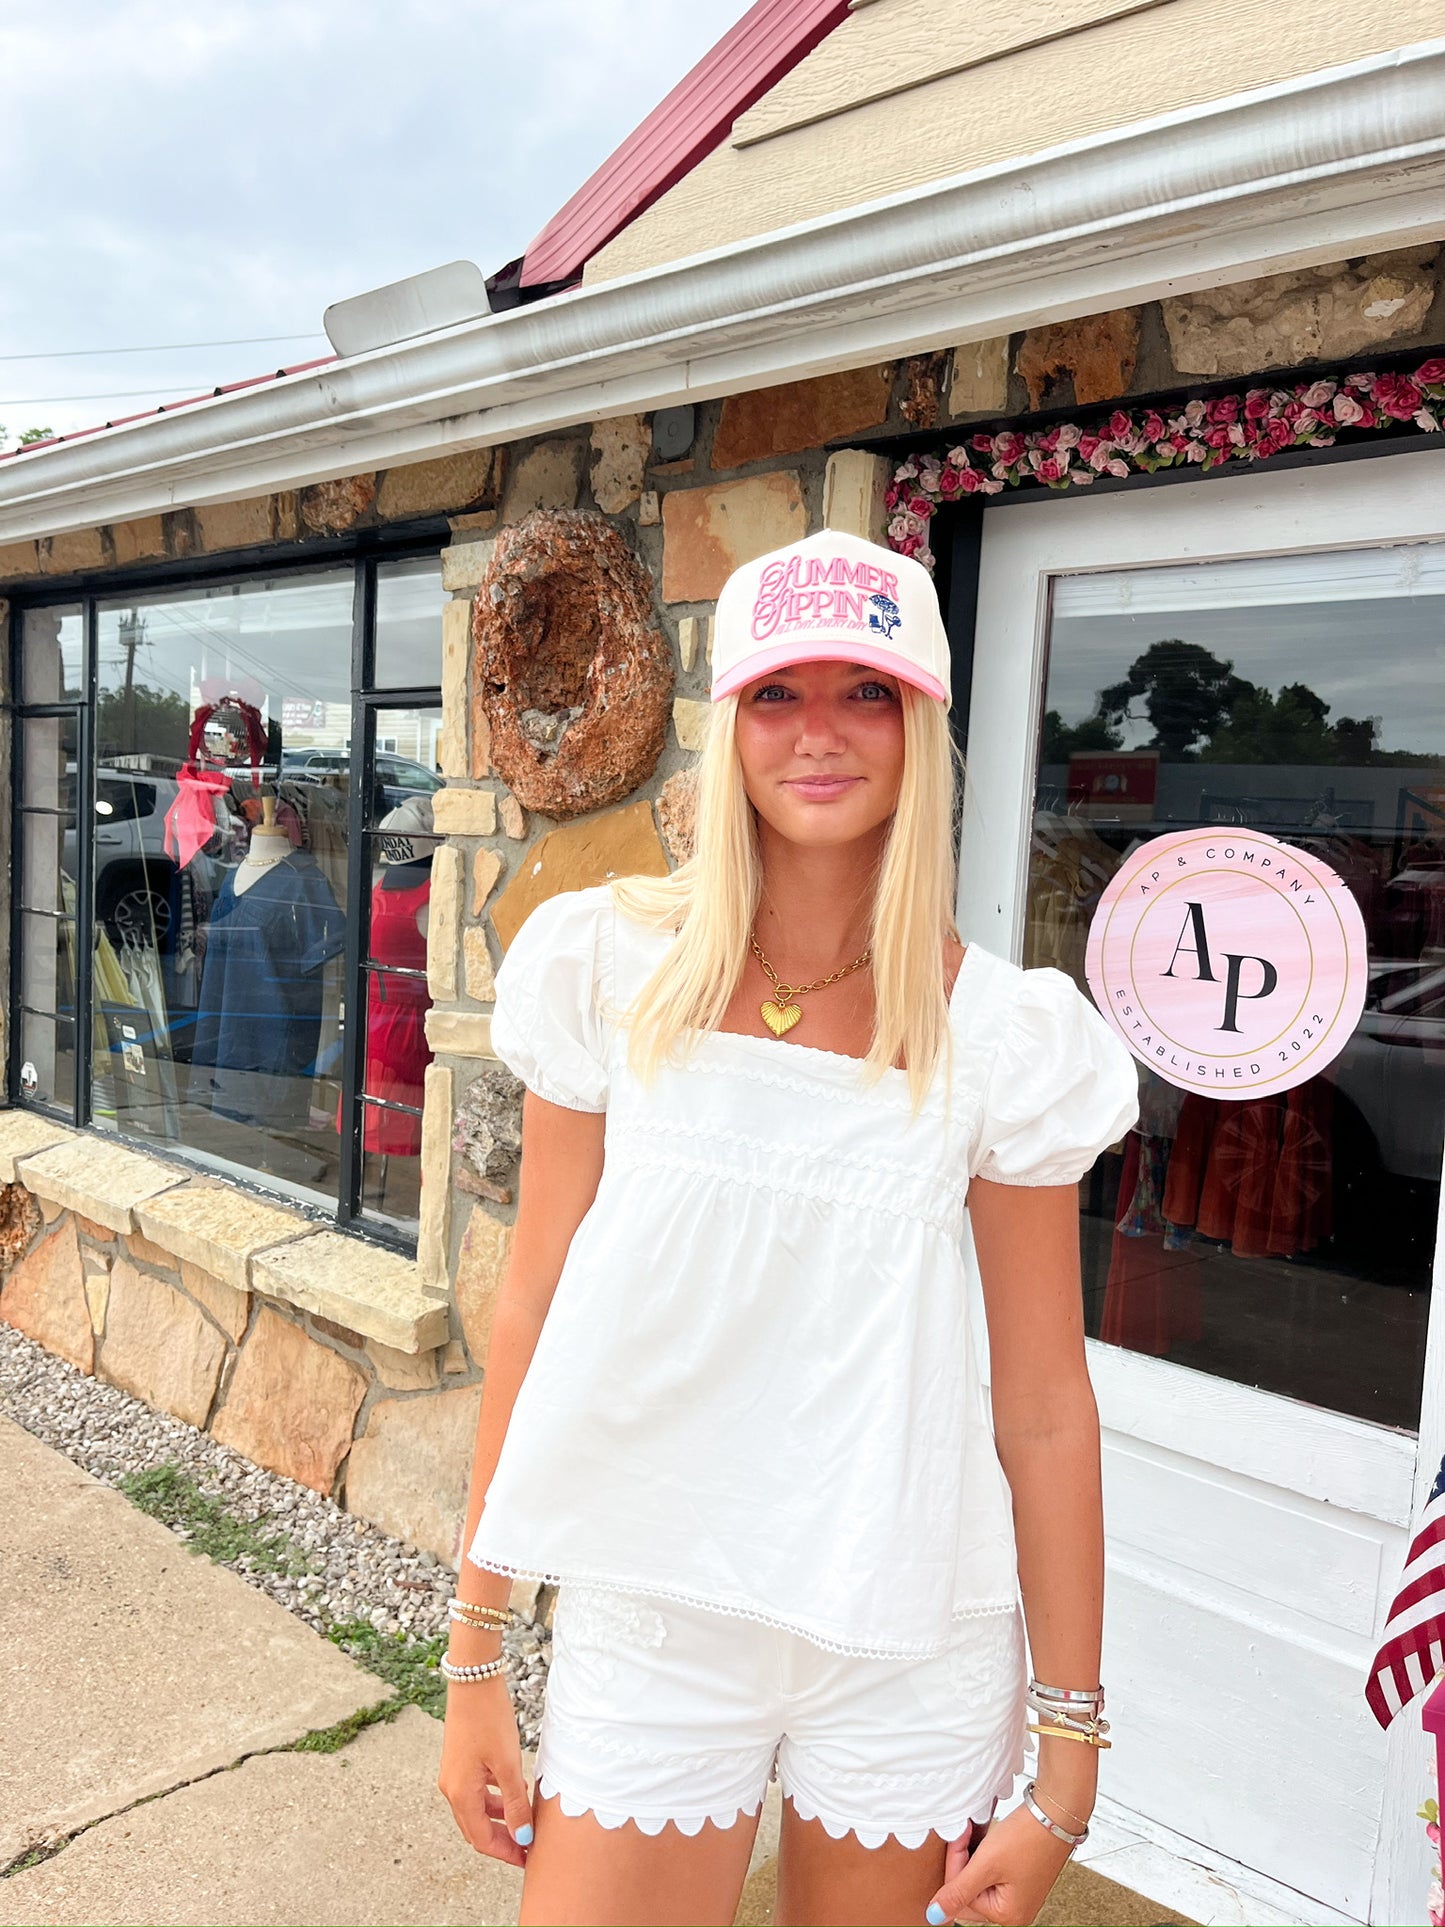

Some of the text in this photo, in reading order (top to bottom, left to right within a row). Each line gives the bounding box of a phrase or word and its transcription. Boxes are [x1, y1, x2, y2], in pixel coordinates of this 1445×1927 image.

[757, 555, 899, 603] SUMMER
[1140, 848, 1315, 906] AP & COMPANY
[1158, 901, 1278, 1034] AP
[1115, 988, 1324, 1079] ESTABLISHED 2022
